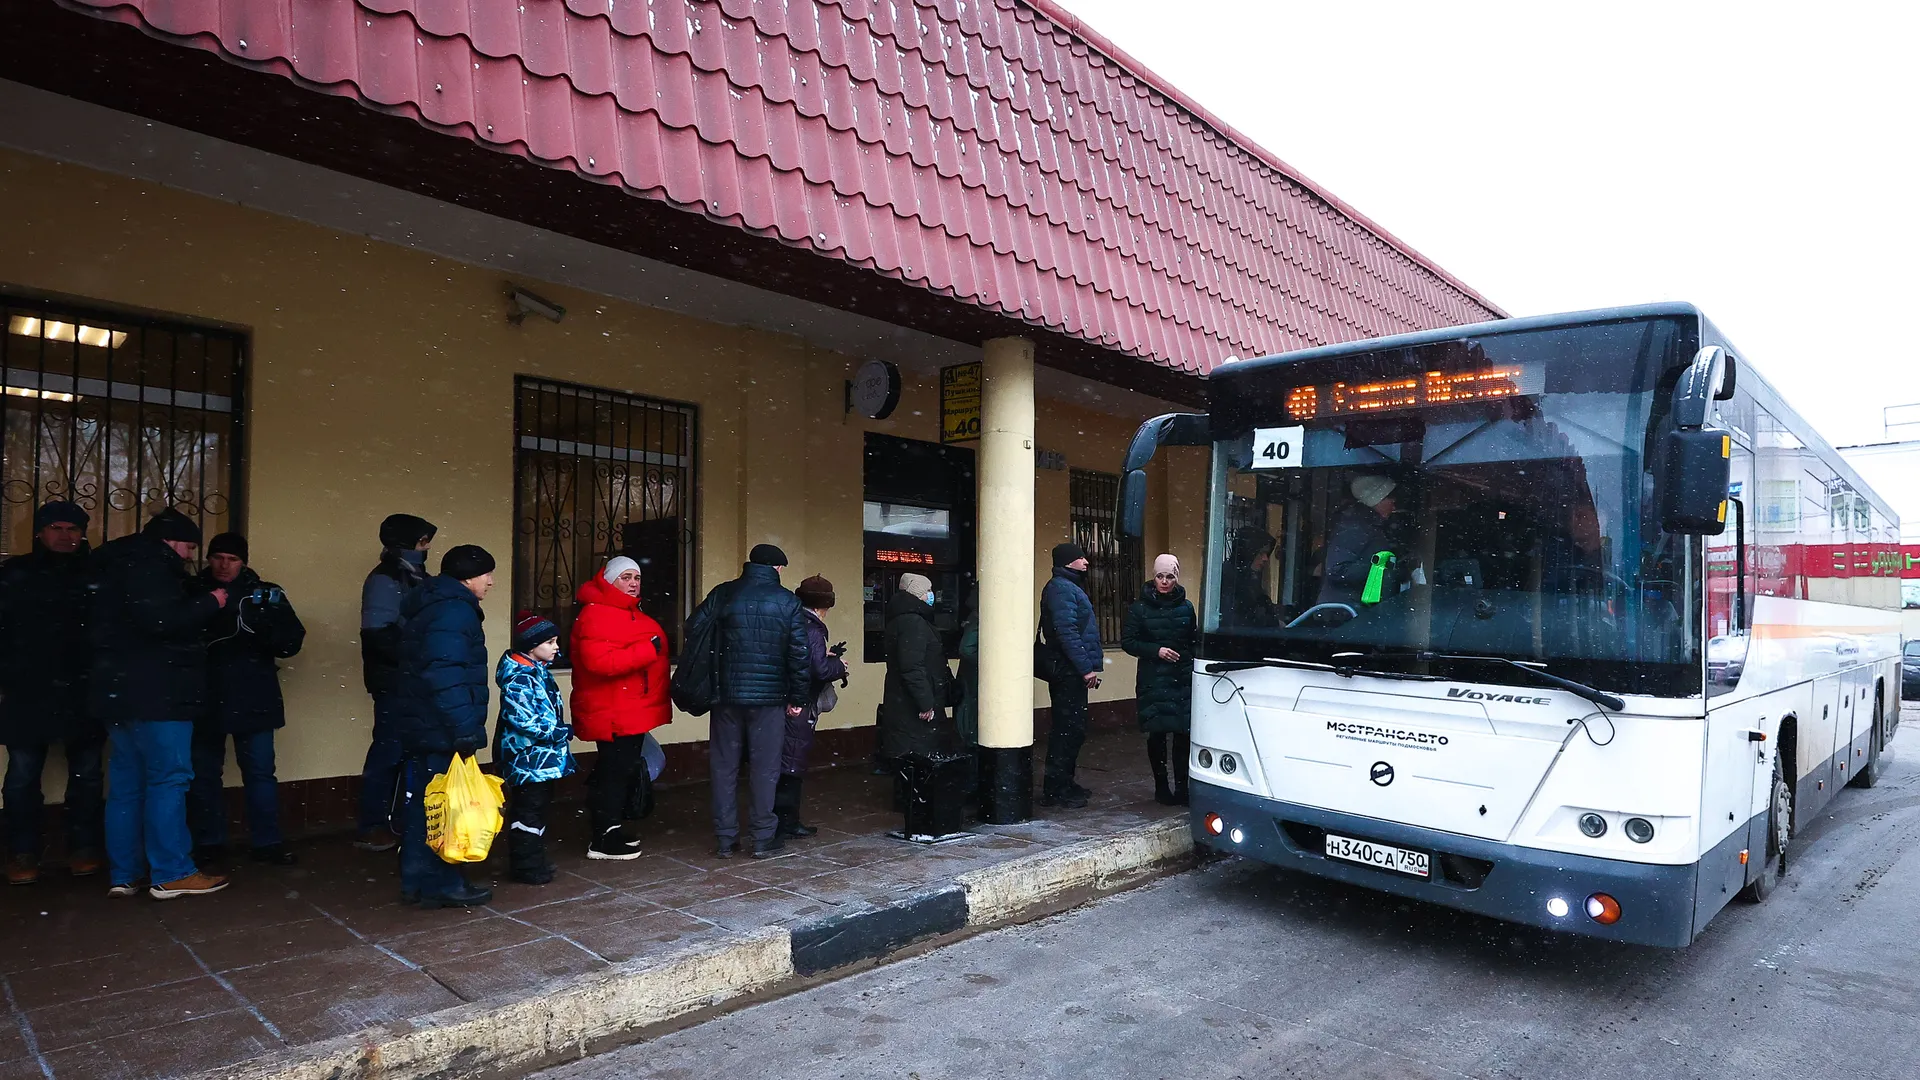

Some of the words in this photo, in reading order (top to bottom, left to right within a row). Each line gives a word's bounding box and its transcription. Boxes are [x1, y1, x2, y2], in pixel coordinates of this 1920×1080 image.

[944, 417, 981, 438] №40
[1262, 441, 1290, 460] 40
[1326, 721, 1449, 746] МОСТРАНСАВТО
[1367, 738, 1397, 747] МАРШРУТЫ
[1397, 742, 1437, 752] ПОДМОСКОВЬЯ
[1404, 864, 1418, 873] RUS
